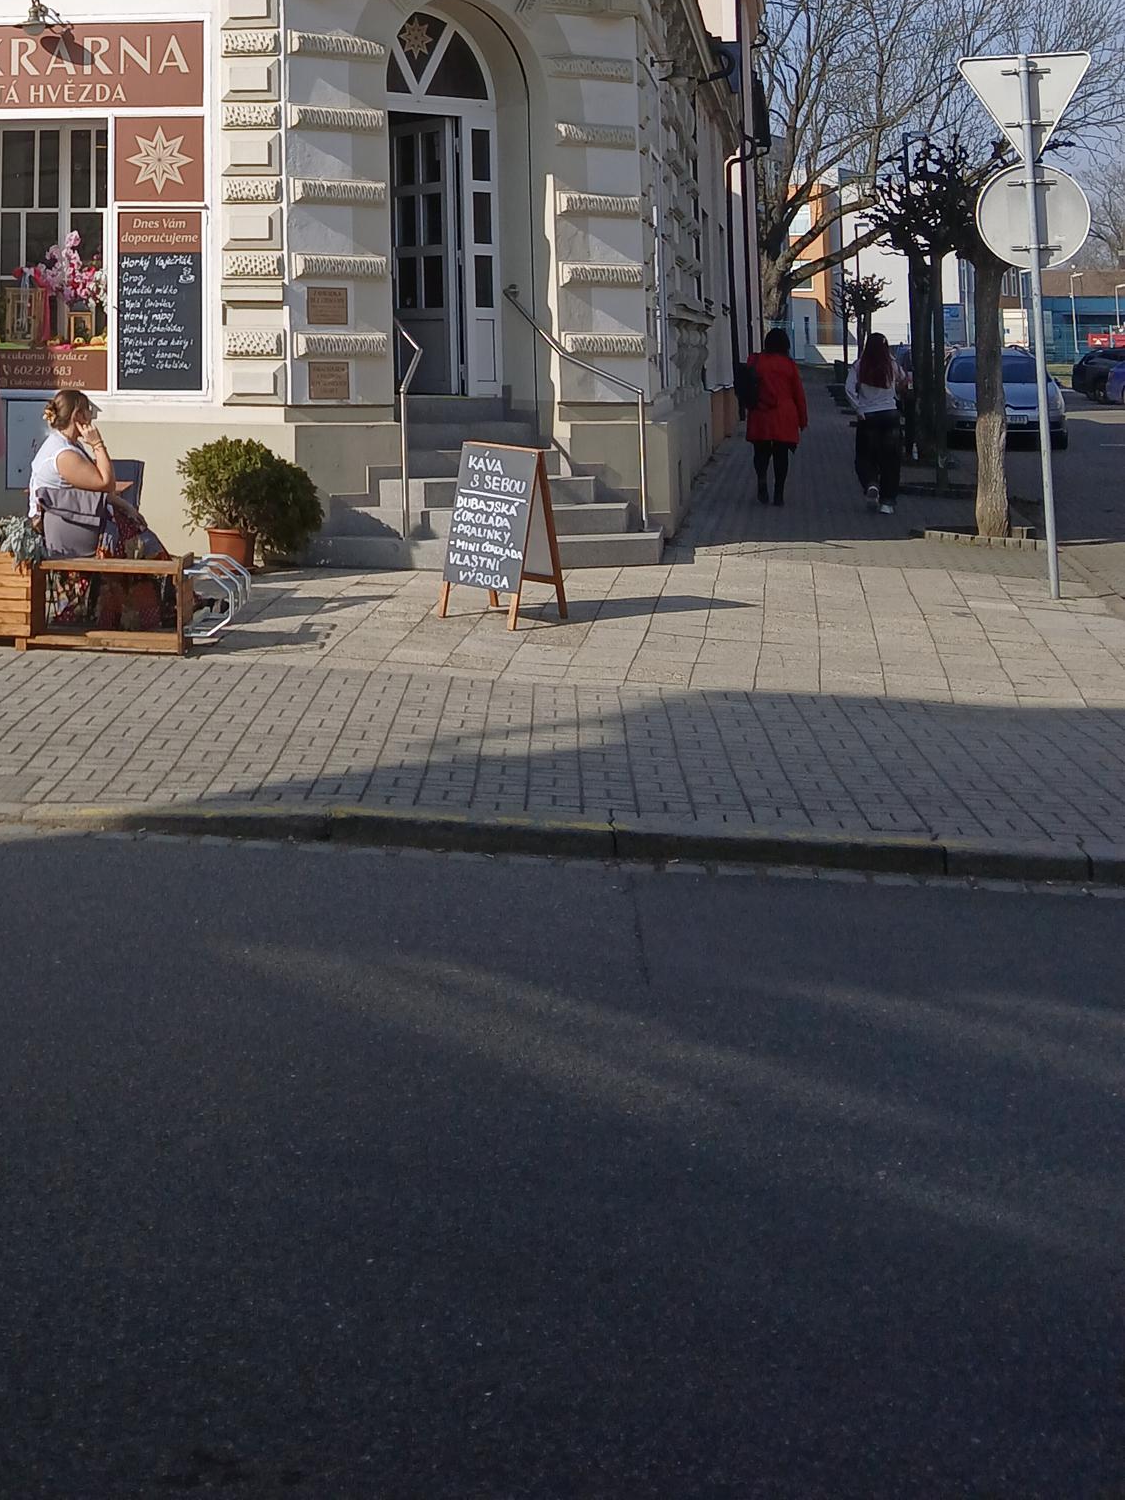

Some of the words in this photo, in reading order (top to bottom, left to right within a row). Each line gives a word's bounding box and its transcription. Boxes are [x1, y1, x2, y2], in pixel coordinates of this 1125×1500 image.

[29, 80, 127, 104] HVĚZDA
[132, 218, 160, 229] Dnes
[162, 218, 186, 229] Vám
[121, 232, 199, 245] doporučujeme
[13, 365, 33, 376] 602
[34, 365, 51, 376] 219
[52, 365, 72, 376] 683
[468, 451, 504, 475] KÁVA
[470, 474, 480, 488] S
[484, 475, 526, 494] SEBOU
[456, 495, 519, 517] DUBAJSKÁ
[449, 551, 507, 572] VLASTNÍ
[459, 567, 510, 589] VÝROBA
